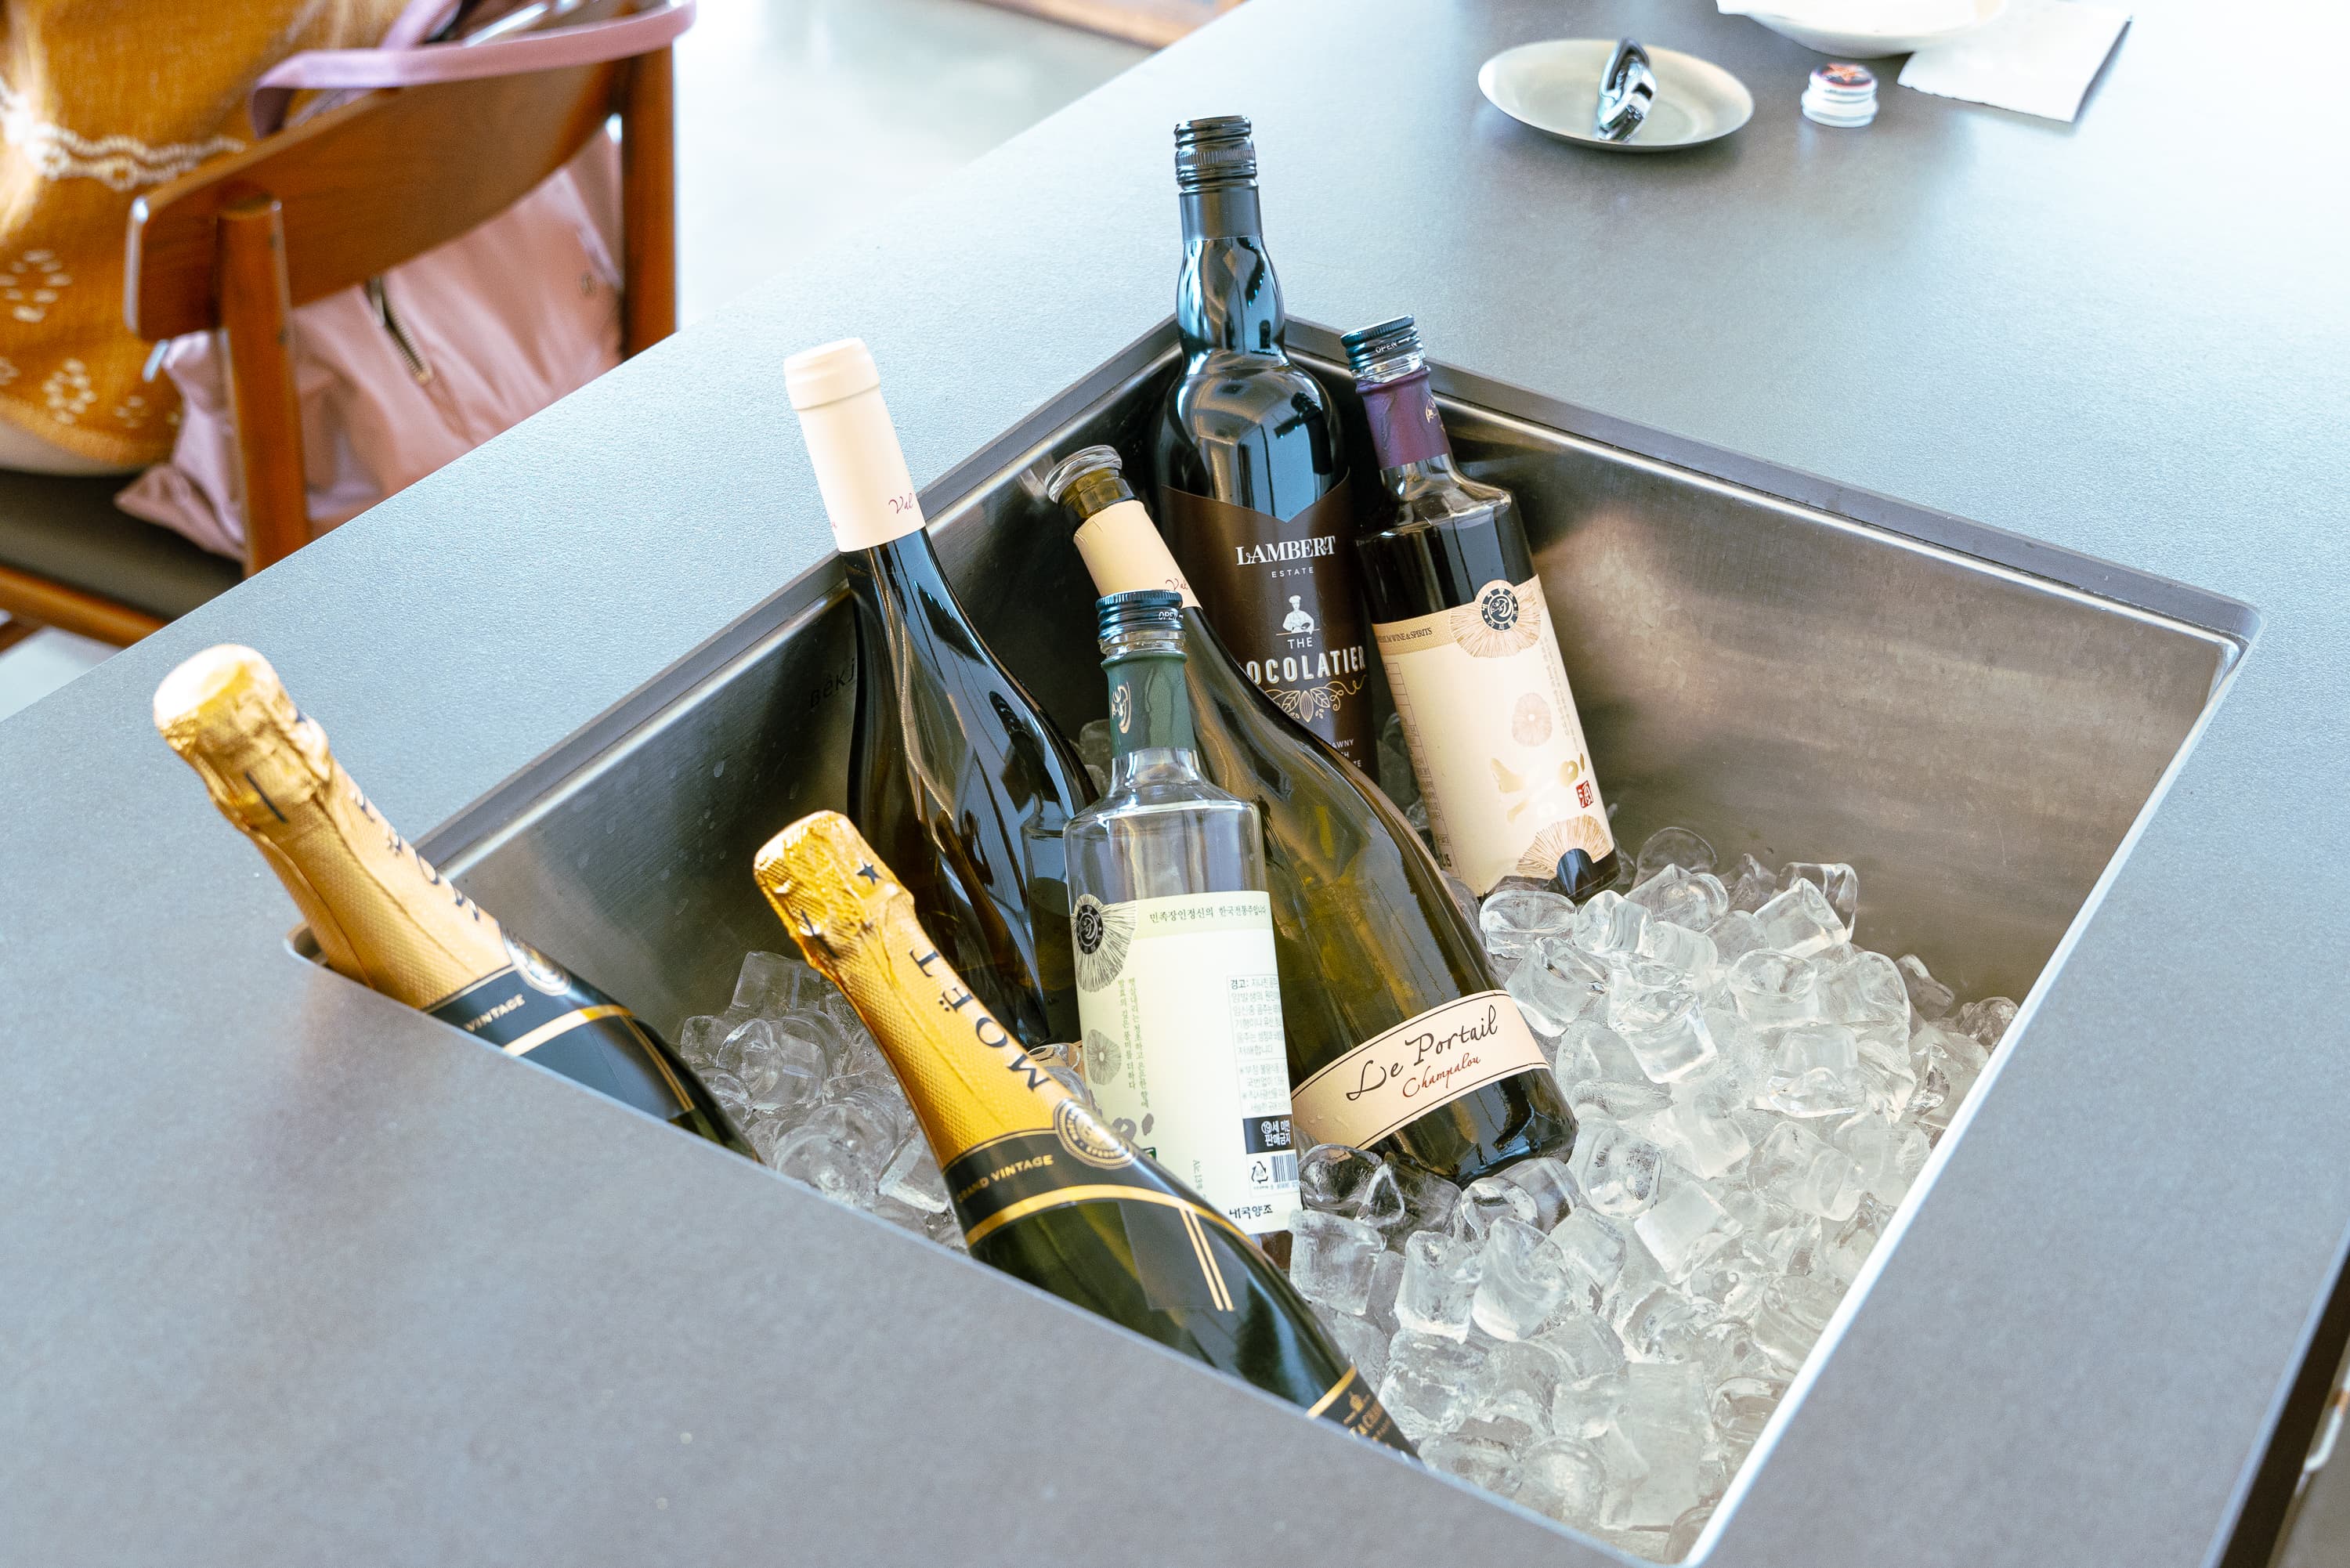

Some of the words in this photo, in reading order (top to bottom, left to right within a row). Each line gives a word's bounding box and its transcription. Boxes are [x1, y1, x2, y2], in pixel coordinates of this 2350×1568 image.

[1375, 341, 1398, 354] OPEN
[1235, 535, 1336, 565] LAMBERT
[1271, 566, 1314, 578] ESTATE
[1159, 611, 1178, 621] OPEN
[1411, 627, 1433, 639] SPIRITS
[1287, 636, 1313, 649] THE
[1246, 645, 1366, 686] OCOLATIER
[1331, 739, 1354, 750] AWNY
[1231, 979, 1249, 990] 경고:
[464, 993, 526, 1032] VINTAGE
[909, 947, 1053, 1093] MOËT
[1346, 1060, 1404, 1101] Le
[1405, 1004, 1498, 1066] Portail
[1402, 1052, 1481, 1098] Champalou
[1264, 1133, 1292, 1147] 판매금지
[990, 1154, 1054, 1182] VINTAGE
[1229, 1204, 1273, 1219] 내국양조
